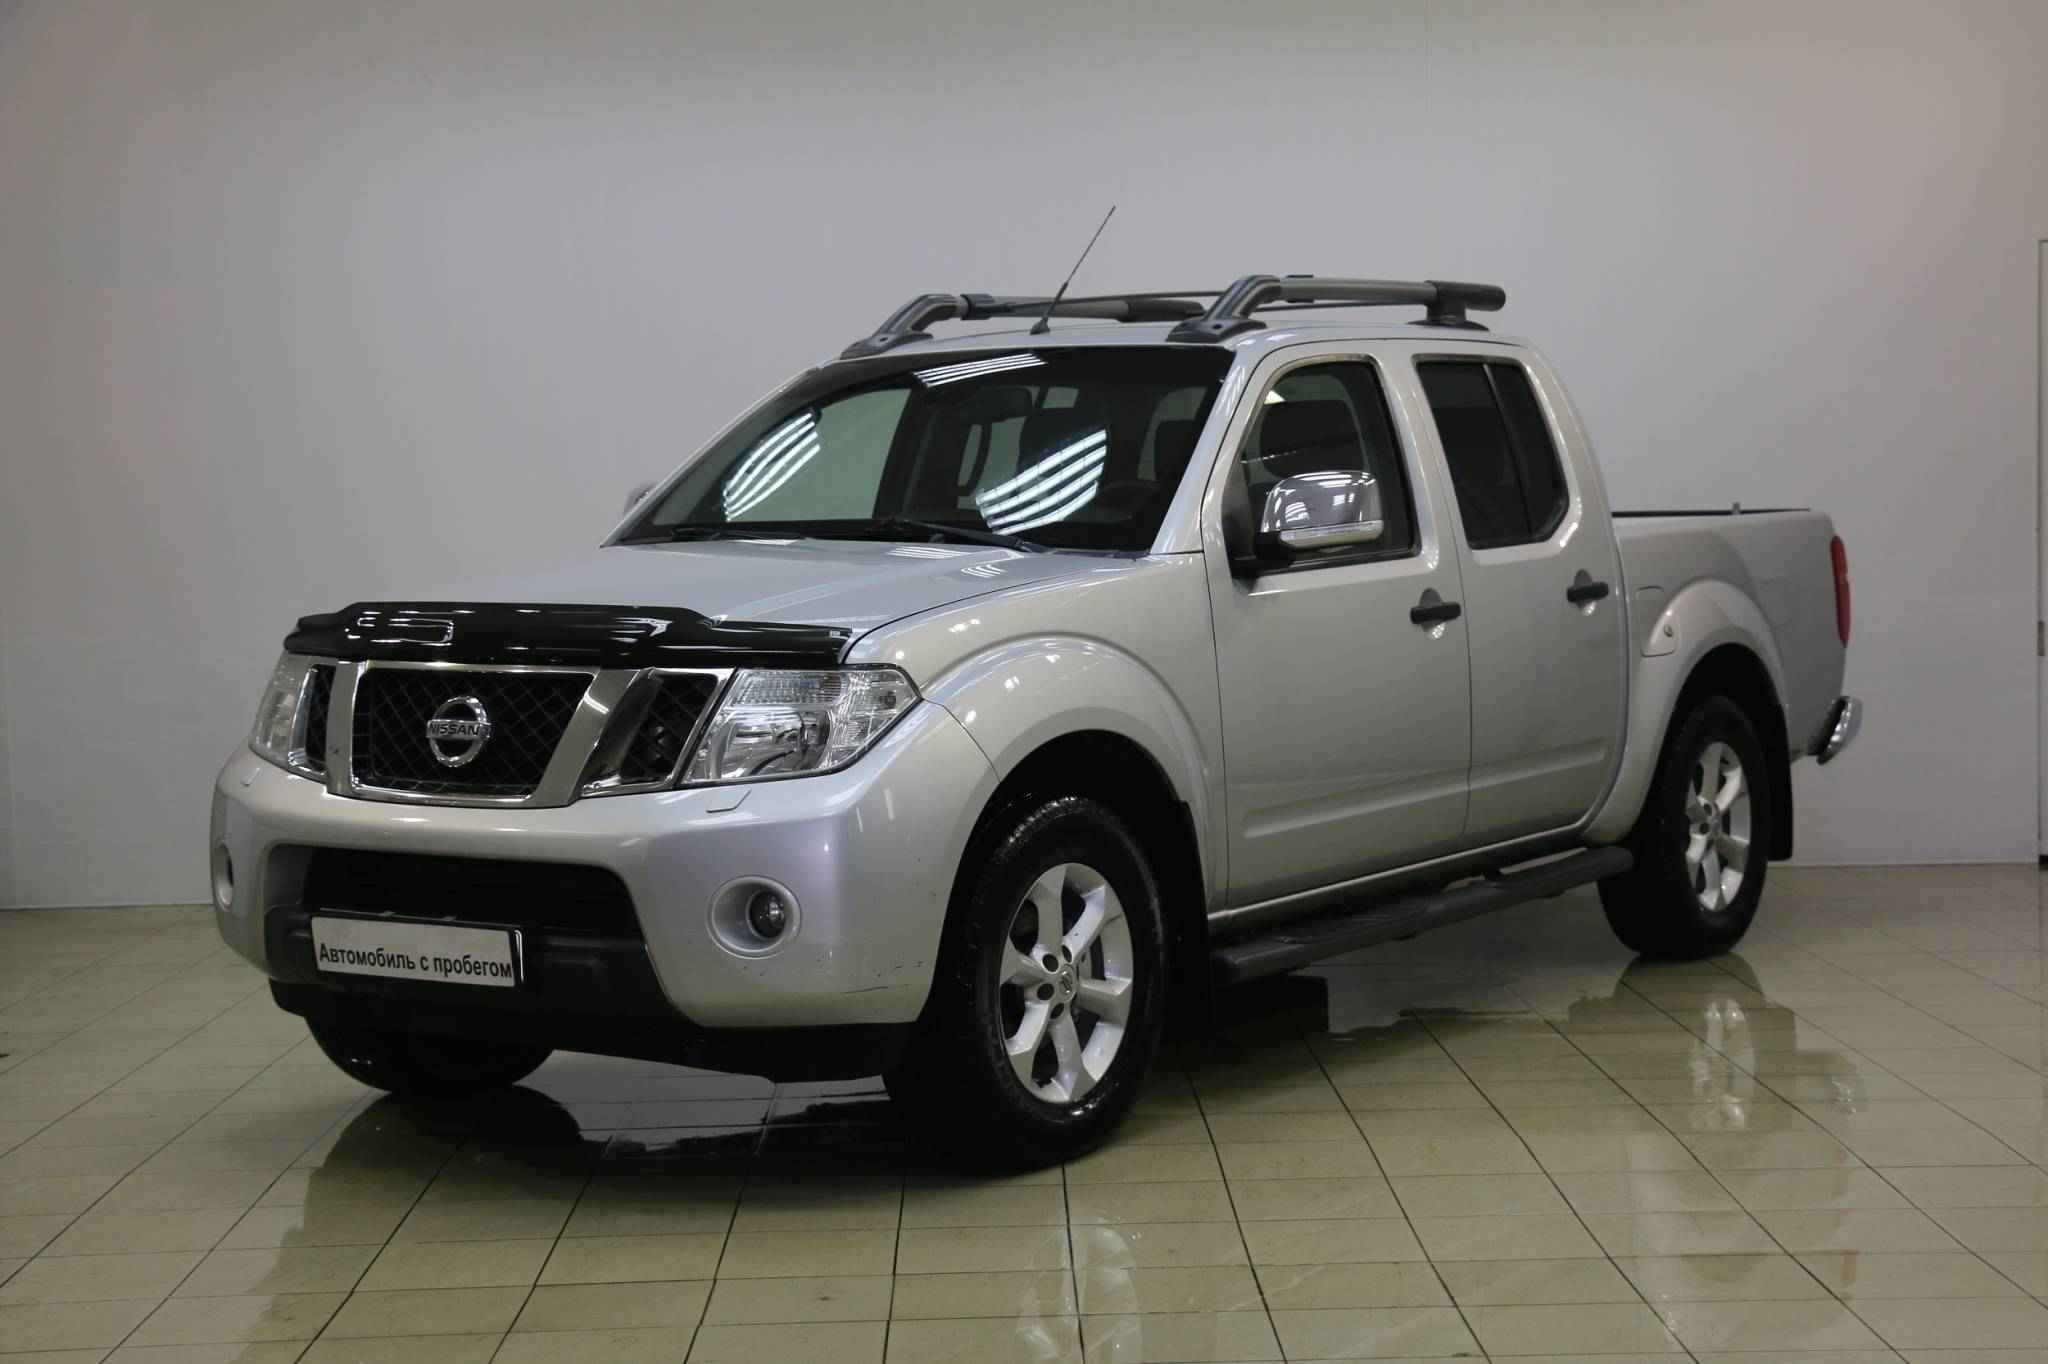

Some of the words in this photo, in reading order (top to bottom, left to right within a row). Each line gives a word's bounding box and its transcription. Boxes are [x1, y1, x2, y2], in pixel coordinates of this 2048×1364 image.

[431, 723, 480, 736] NISSAN
[319, 943, 416, 970] Автомобиль
[420, 956, 429, 971] с
[434, 955, 512, 978] пробегом
